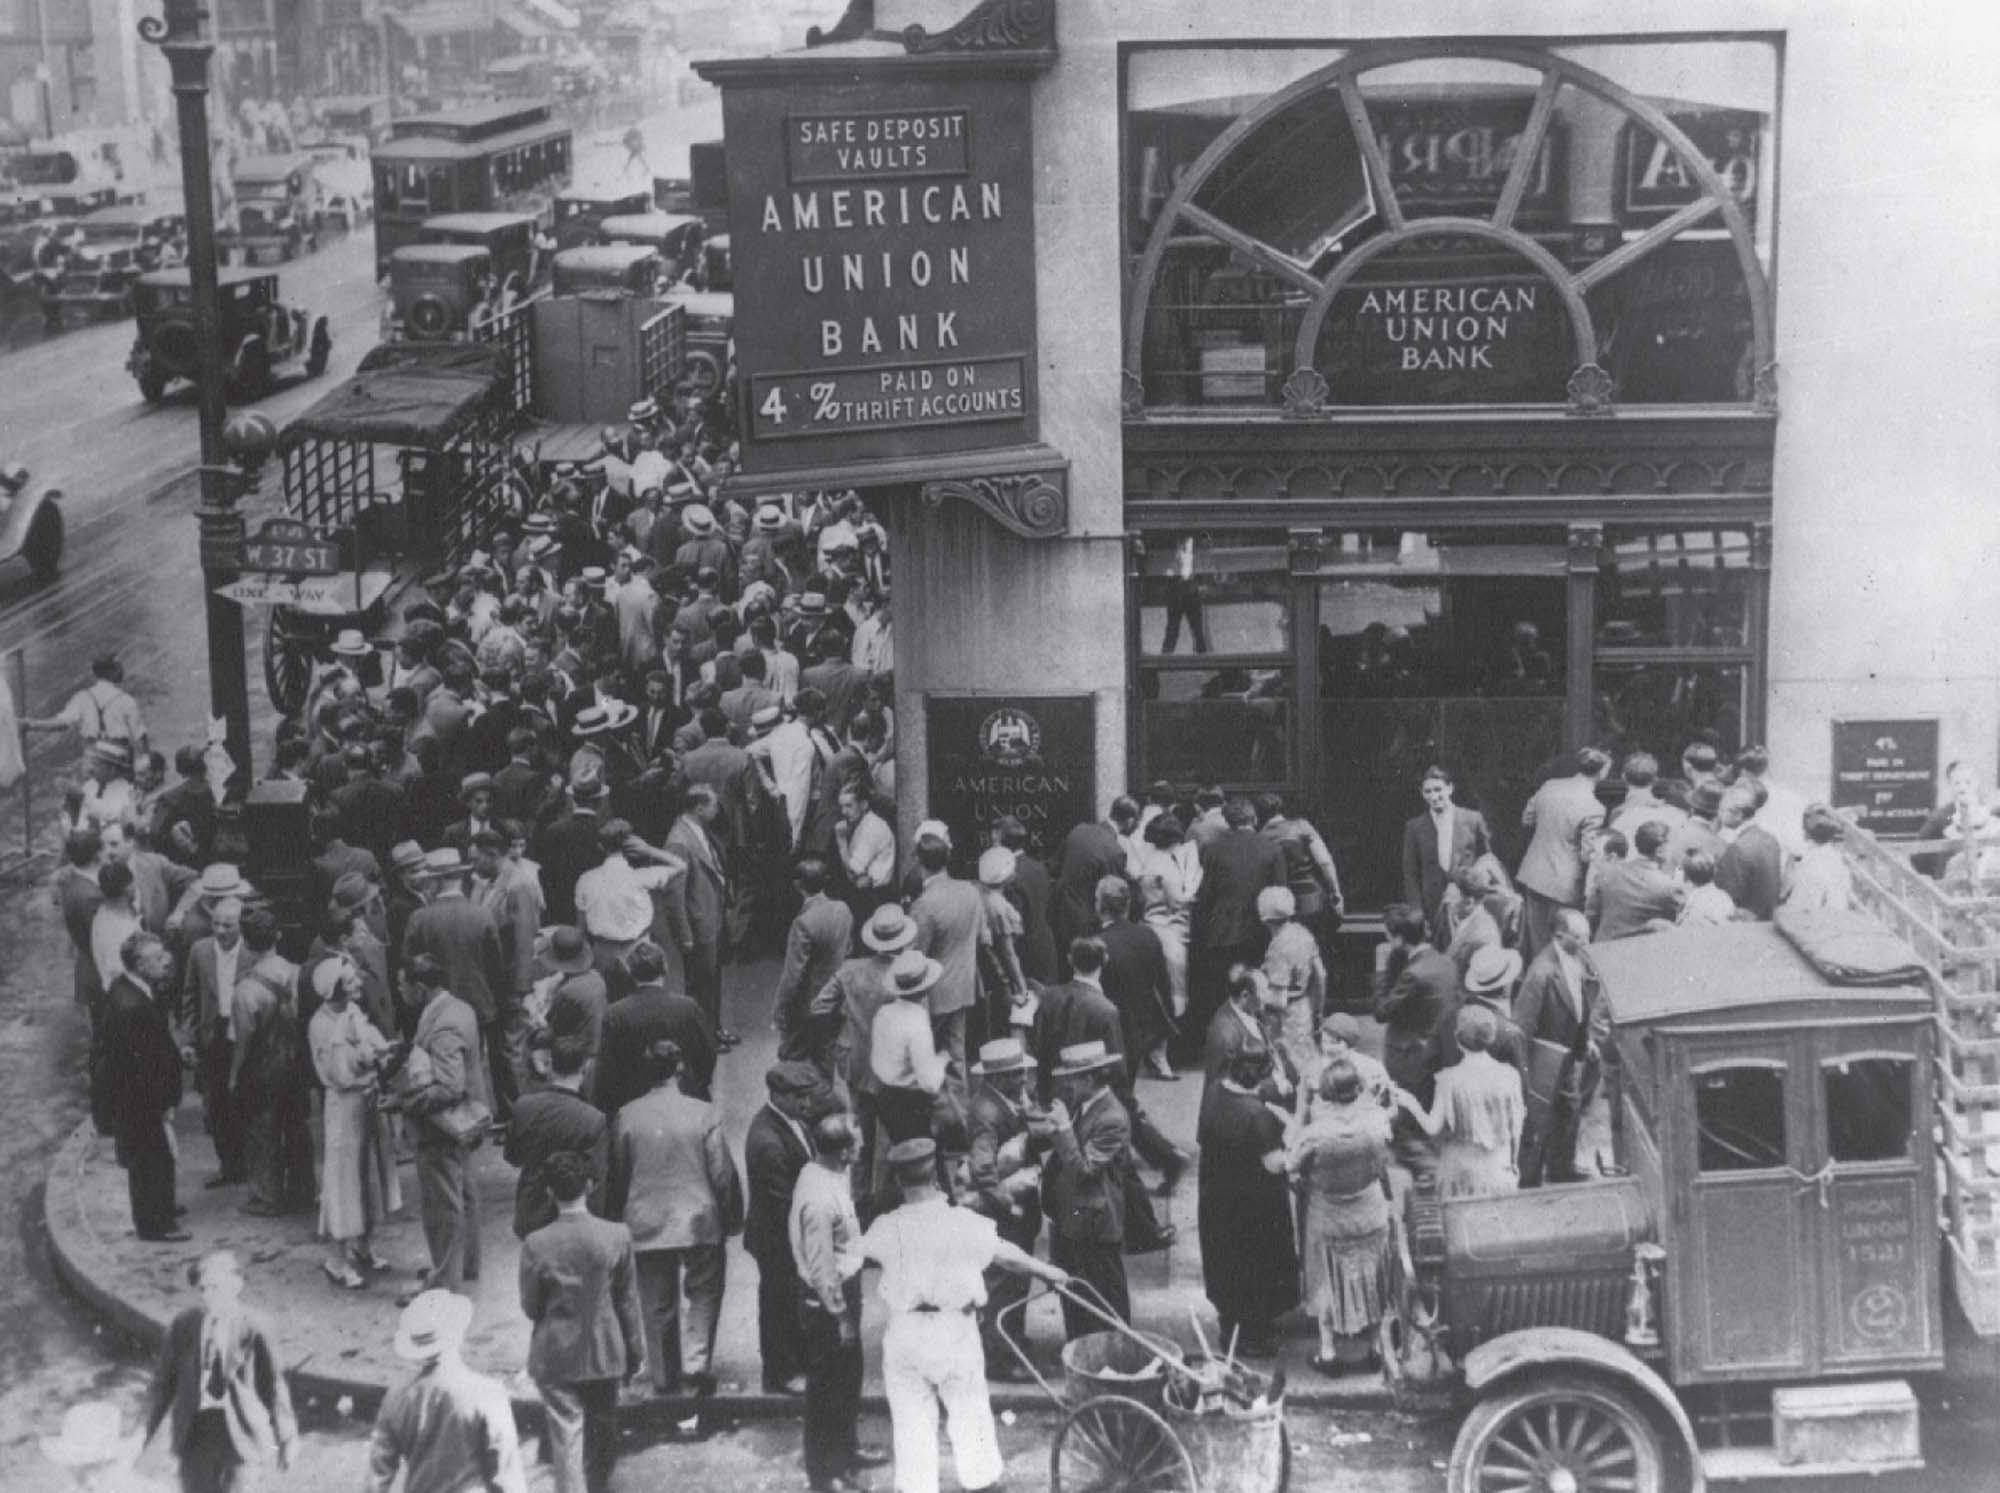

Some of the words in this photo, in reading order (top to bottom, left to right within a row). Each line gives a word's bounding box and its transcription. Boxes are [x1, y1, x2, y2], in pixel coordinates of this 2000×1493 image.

[800, 121, 857, 143] SAFE
[867, 116, 963, 141] DEPOSIT
[837, 146, 927, 169] VAULTS
[762, 183, 1001, 232] AMERICAN
[804, 247, 969, 292] UNION
[1359, 287, 1536, 314] AMERICAN
[822, 312, 958, 356] BANK
[1387, 316, 1508, 341] UNION
[1402, 345, 1493, 370] BANK
[881, 370, 933, 392] PAID
[947, 366, 975, 387] ON
[843, 397, 914, 422] THRIFT
[921, 388, 1021, 417] ACCOUNTS
[271, 545, 295, 568] 37
[304, 547, 328, 570] ST
[952, 776, 1069, 793] AMERICAN
[975, 803, 1047, 820] UNION
